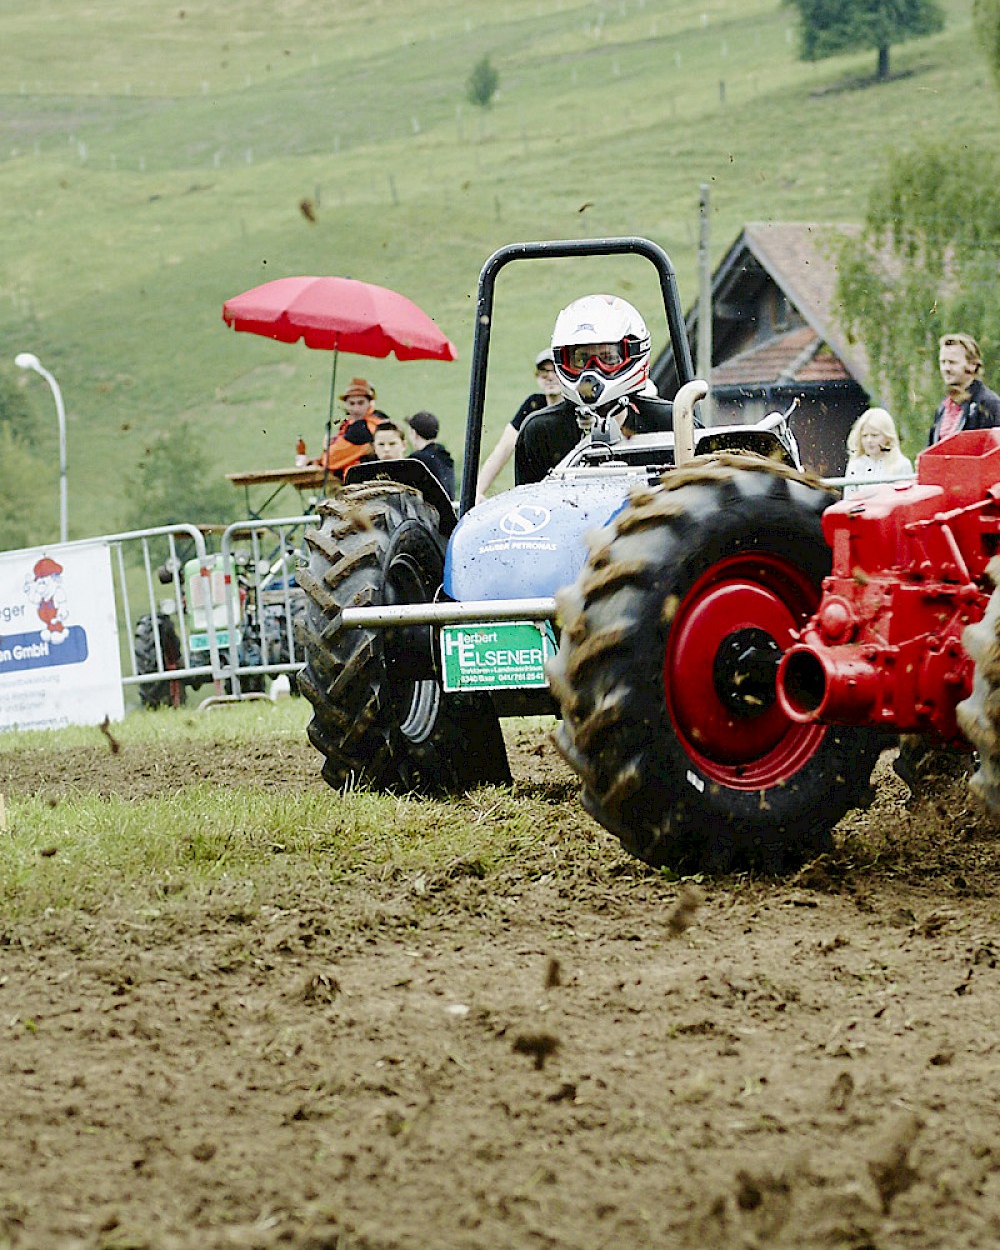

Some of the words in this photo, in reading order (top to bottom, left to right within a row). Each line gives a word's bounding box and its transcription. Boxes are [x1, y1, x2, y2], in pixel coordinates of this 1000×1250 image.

[13, 641, 49, 661] GmbH
[445, 632, 498, 656] Herbert
[459, 643, 543, 667] ELSENER
